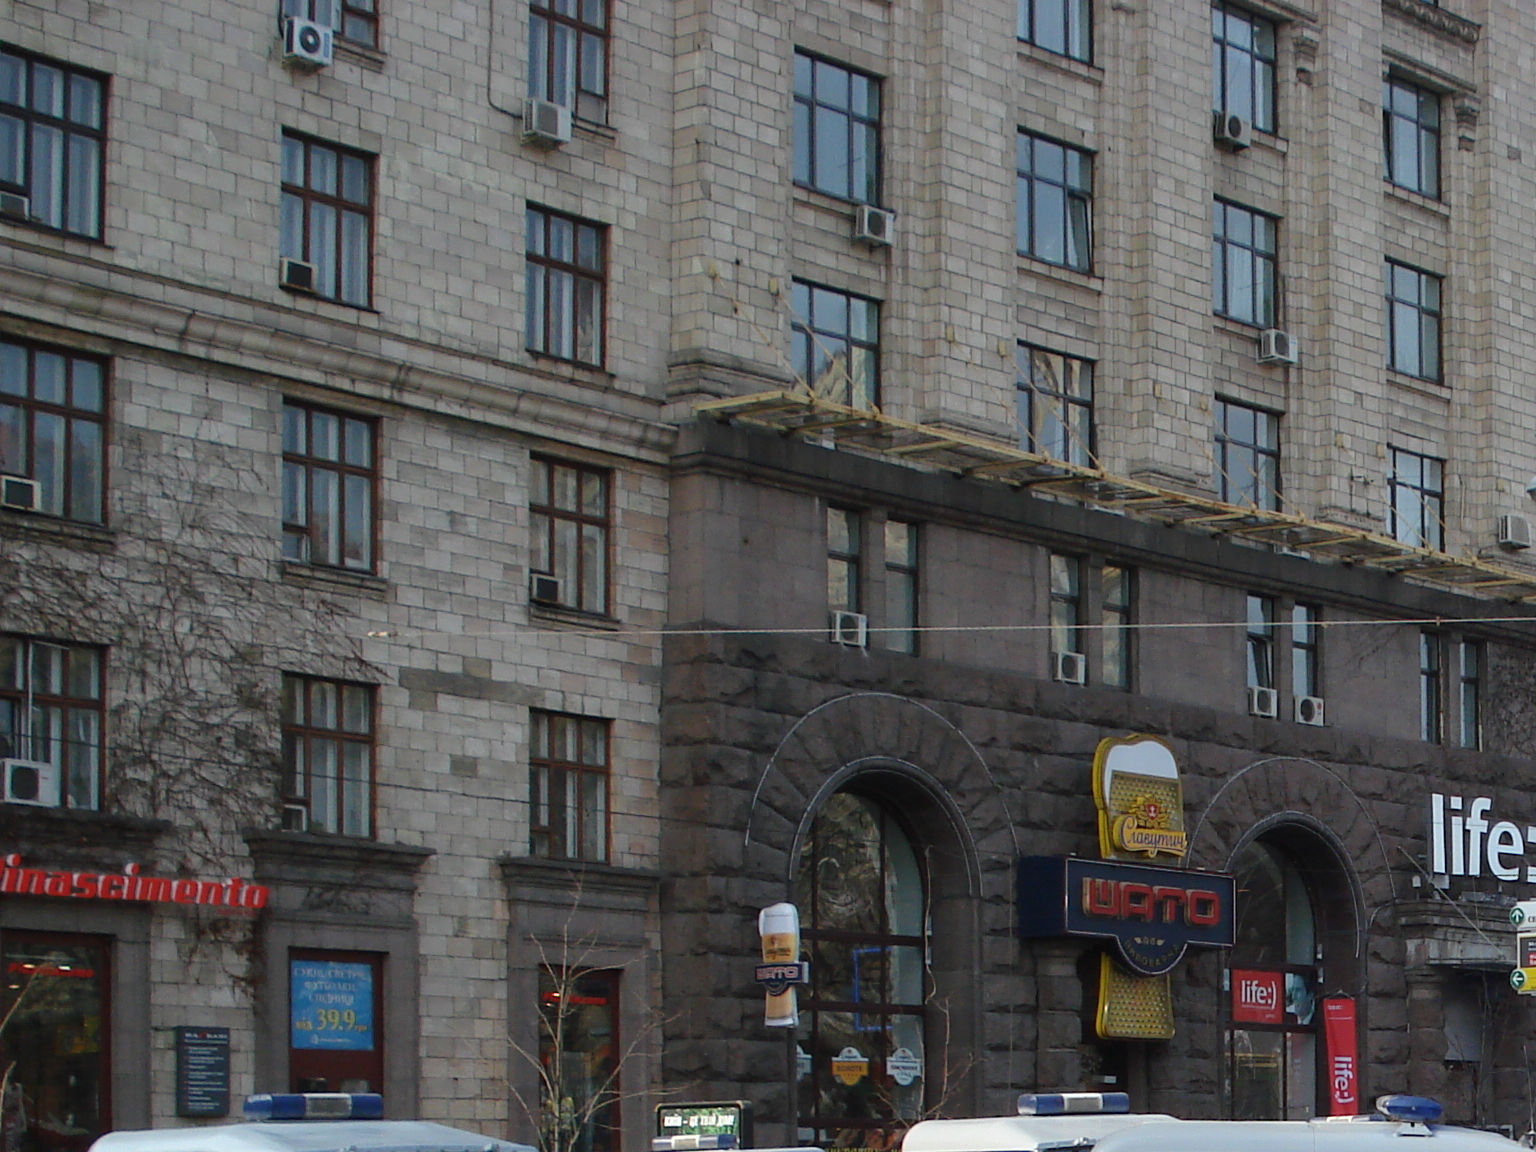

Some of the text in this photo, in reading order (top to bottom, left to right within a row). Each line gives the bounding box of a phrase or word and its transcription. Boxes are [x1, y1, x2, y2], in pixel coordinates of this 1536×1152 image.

[1122, 816, 1186, 854] Славутич
[0, 853, 271, 908] inascimento
[1084, 877, 1220, 927] ШАТО
[756, 966, 799, 981] ШАТО
[1241, 980, 1277, 1009] life:)
[315, 1009, 356, 1032] 39.9
[1334, 1056, 1355, 1104] life:)
